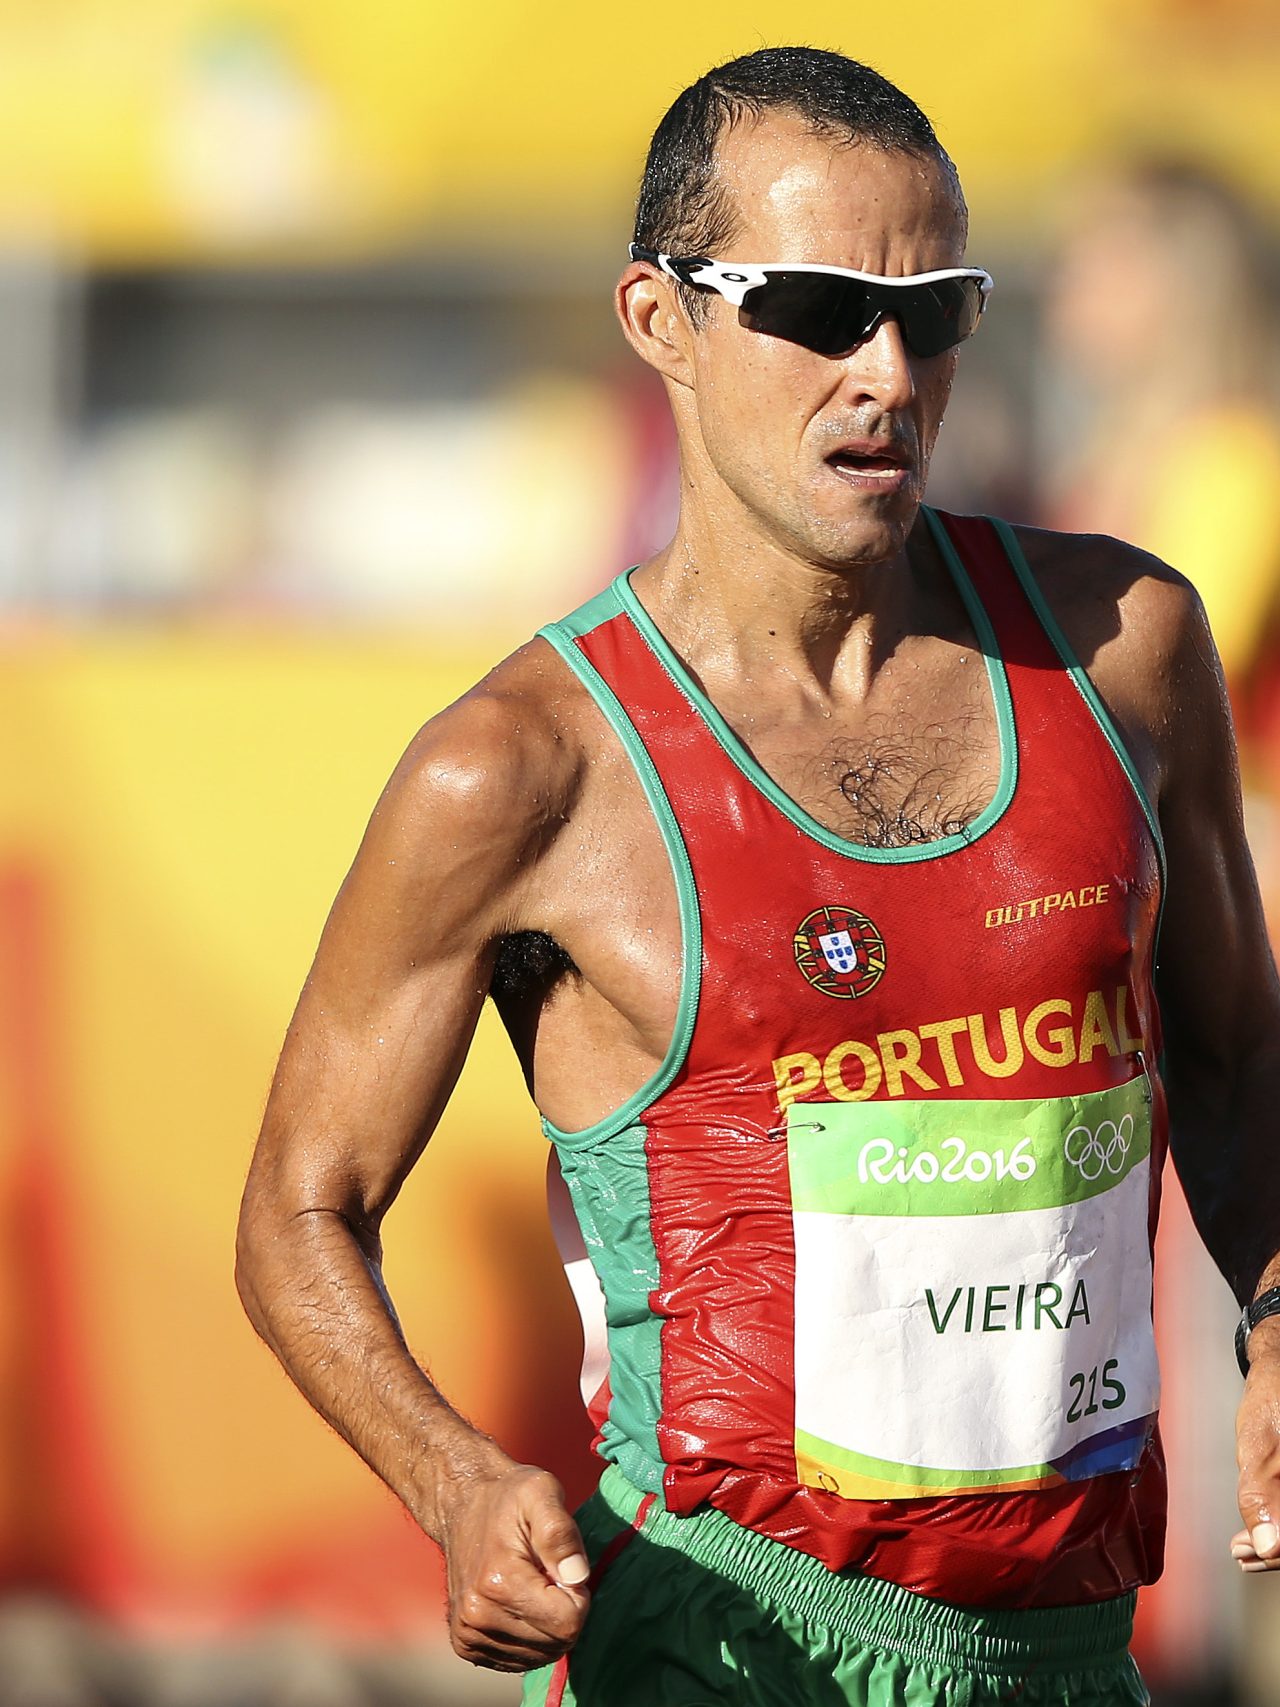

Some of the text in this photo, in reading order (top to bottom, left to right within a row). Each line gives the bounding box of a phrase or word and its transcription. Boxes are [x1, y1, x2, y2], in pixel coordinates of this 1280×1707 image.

[985, 884, 1110, 928] OUTPACE
[772, 986, 1145, 1116] PORTUGAL
[925, 1279, 1091, 1335] VIEIRA
[1066, 1358, 1127, 1423] 215
